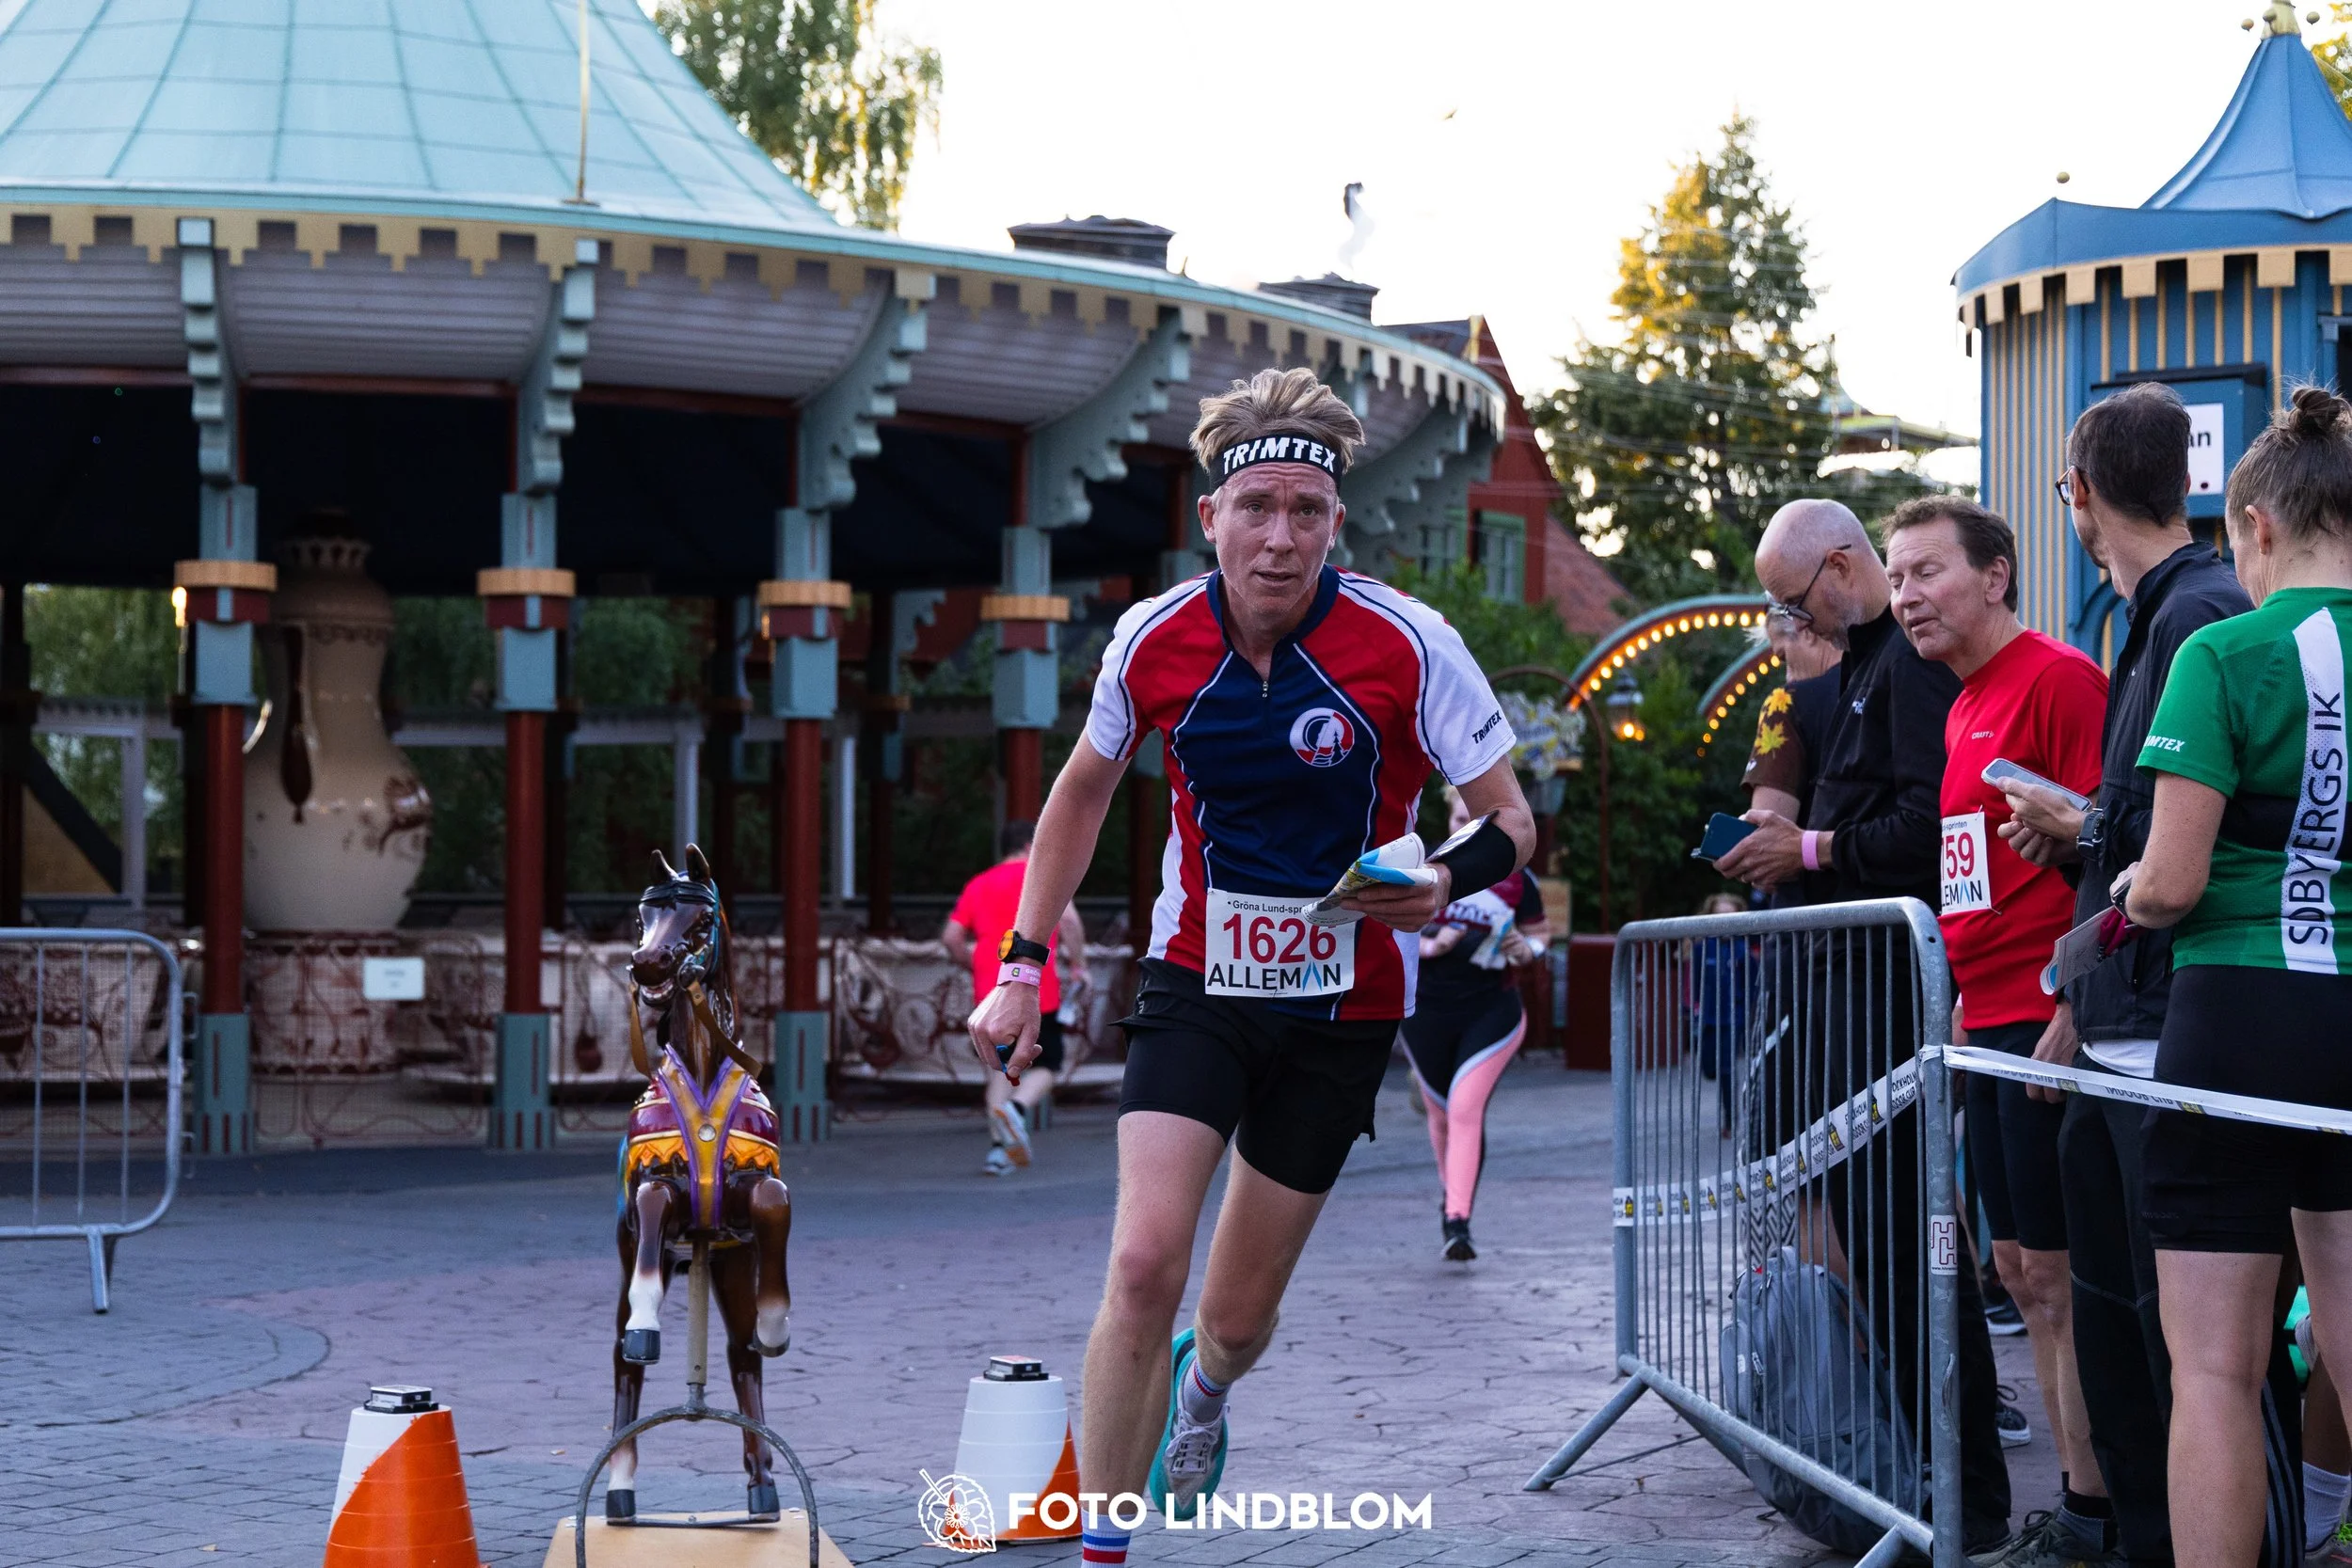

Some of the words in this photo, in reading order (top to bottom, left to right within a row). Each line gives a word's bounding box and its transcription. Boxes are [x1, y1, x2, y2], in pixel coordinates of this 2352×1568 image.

[1223, 437, 1336, 474] TRIMTEX
[2312, 691, 2343, 732] IK
[1232, 900, 1260, 911] Gröna
[1262, 903, 1306, 914] Lund-spr
[1223, 912, 1337, 964] 1626
[1206, 961, 1342, 992] ALLEMAN
